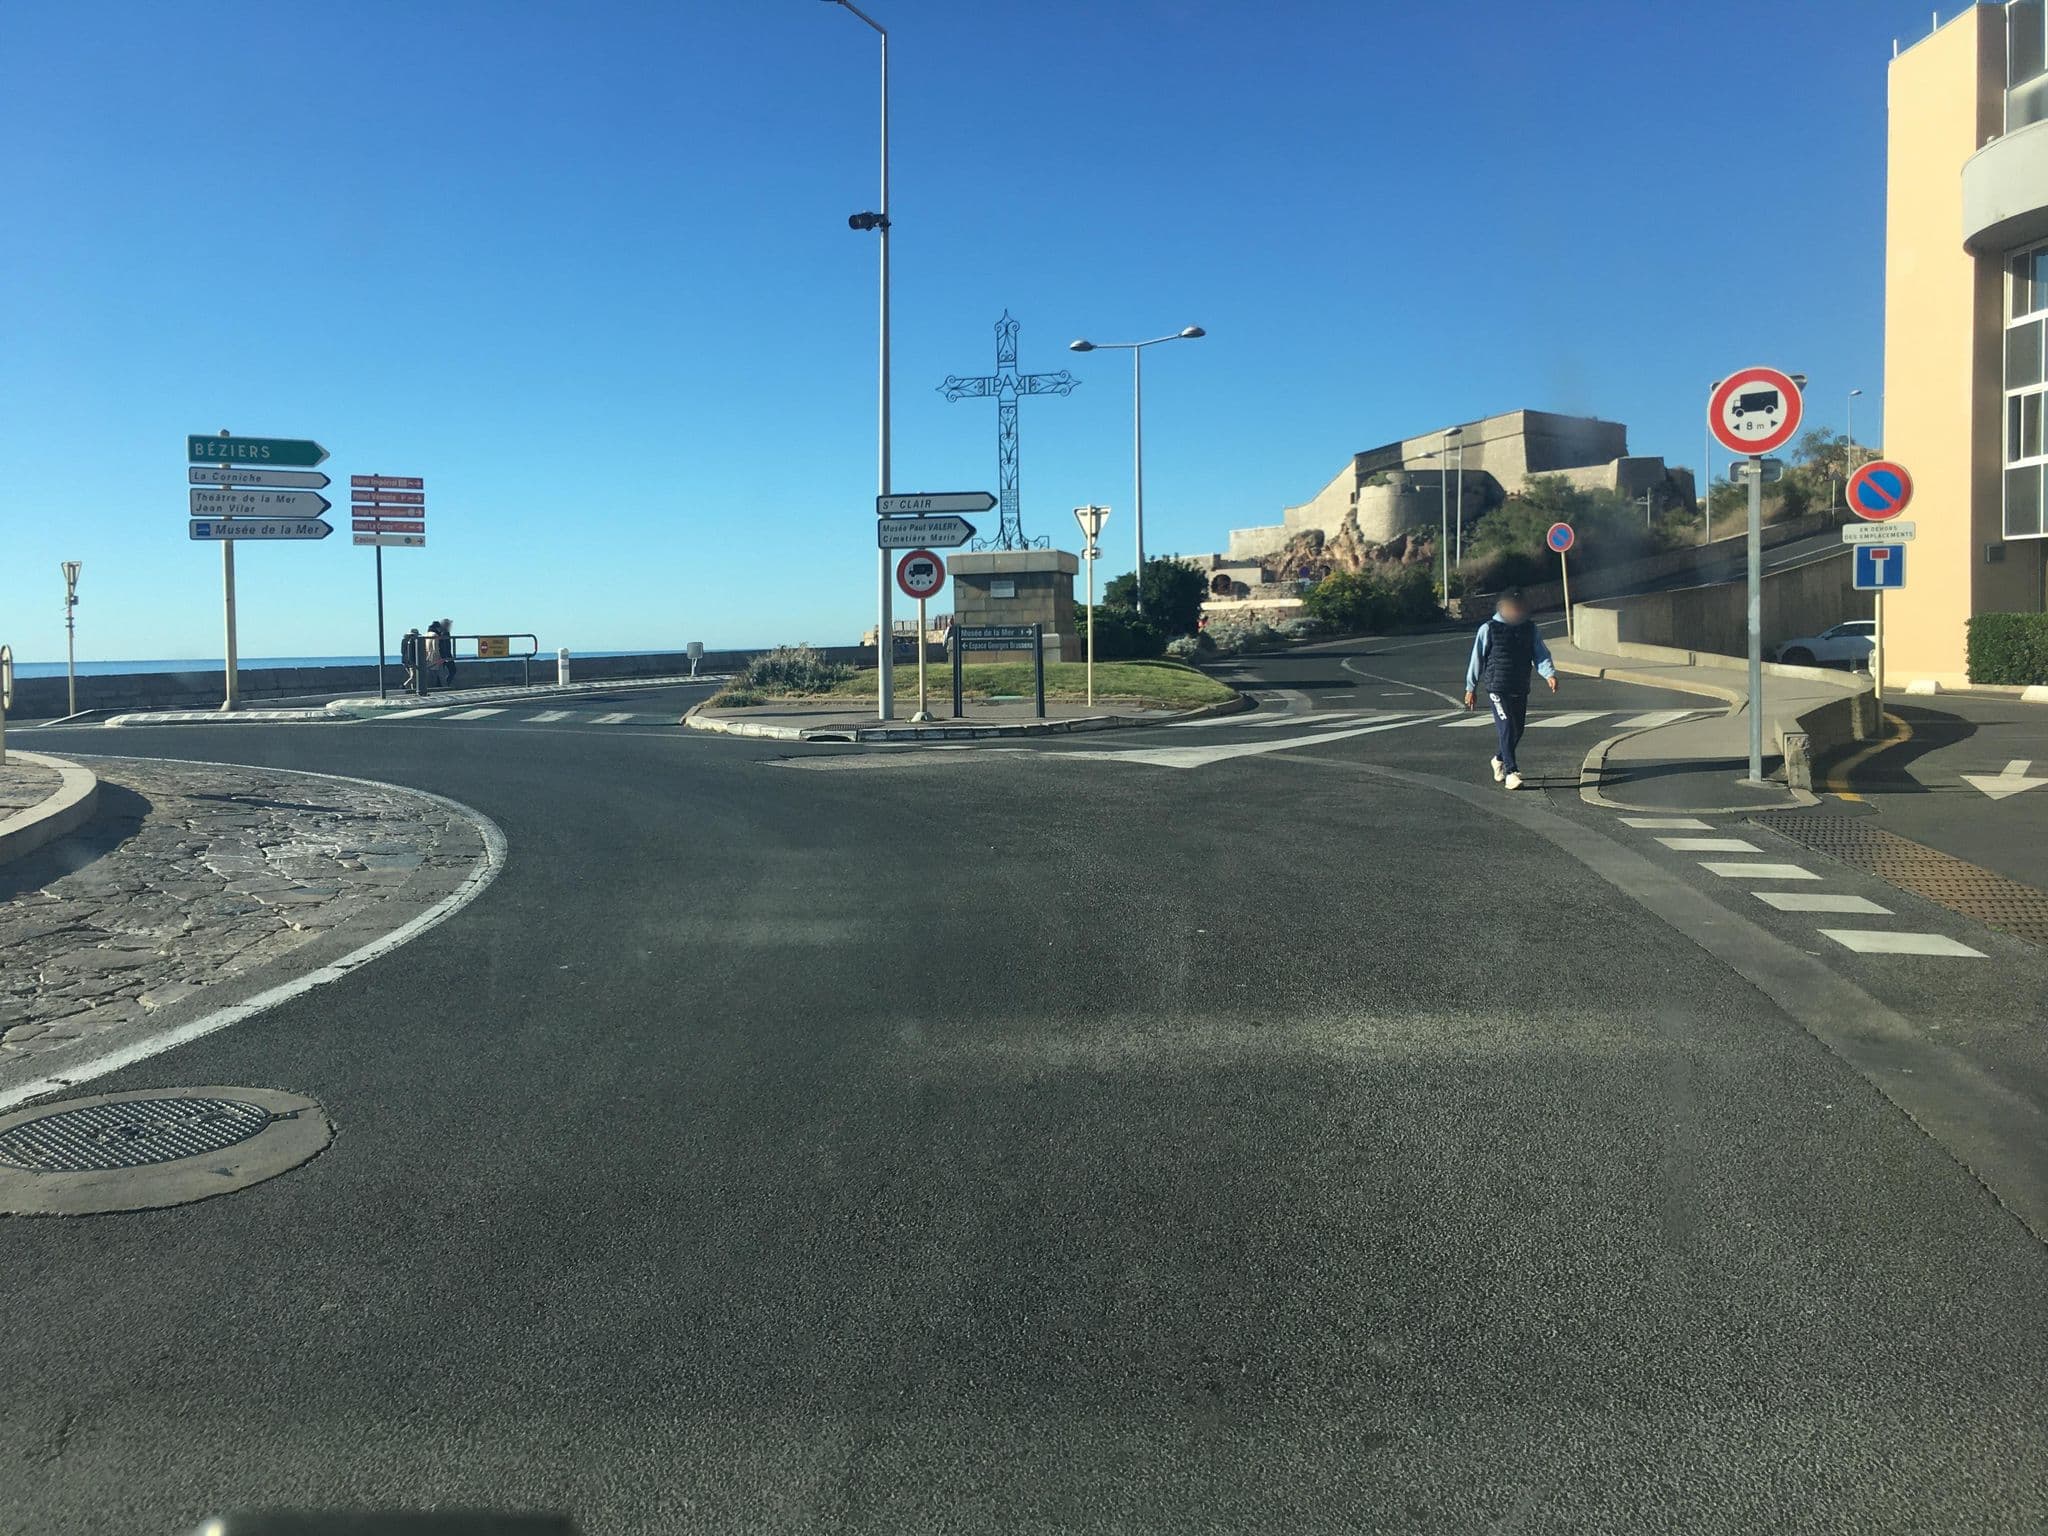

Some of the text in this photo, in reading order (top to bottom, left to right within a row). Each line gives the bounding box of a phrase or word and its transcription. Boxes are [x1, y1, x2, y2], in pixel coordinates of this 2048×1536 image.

[1746, 421, 1753, 430] 8
[194, 441, 271, 459] BÉZIERS
[194, 471, 262, 483] La Corniche
[242, 494, 255, 503] de
[260, 494, 271, 503] la
[276, 495, 297, 504] Mer
[899, 498, 932, 509] CLAIR
[196, 503, 256, 513] Jean Vilar
[215, 523, 320, 535] Musée de la Mer
[883, 524, 907, 532] Musée
[909, 523, 926, 531] Paul
[930, 534, 956, 542] Marin
[1859, 531, 1914, 541] EMPLACEMENTS
[983, 628, 992, 637] de
[993, 628, 1000, 636] la
[1001, 628, 1015, 636] Mer
